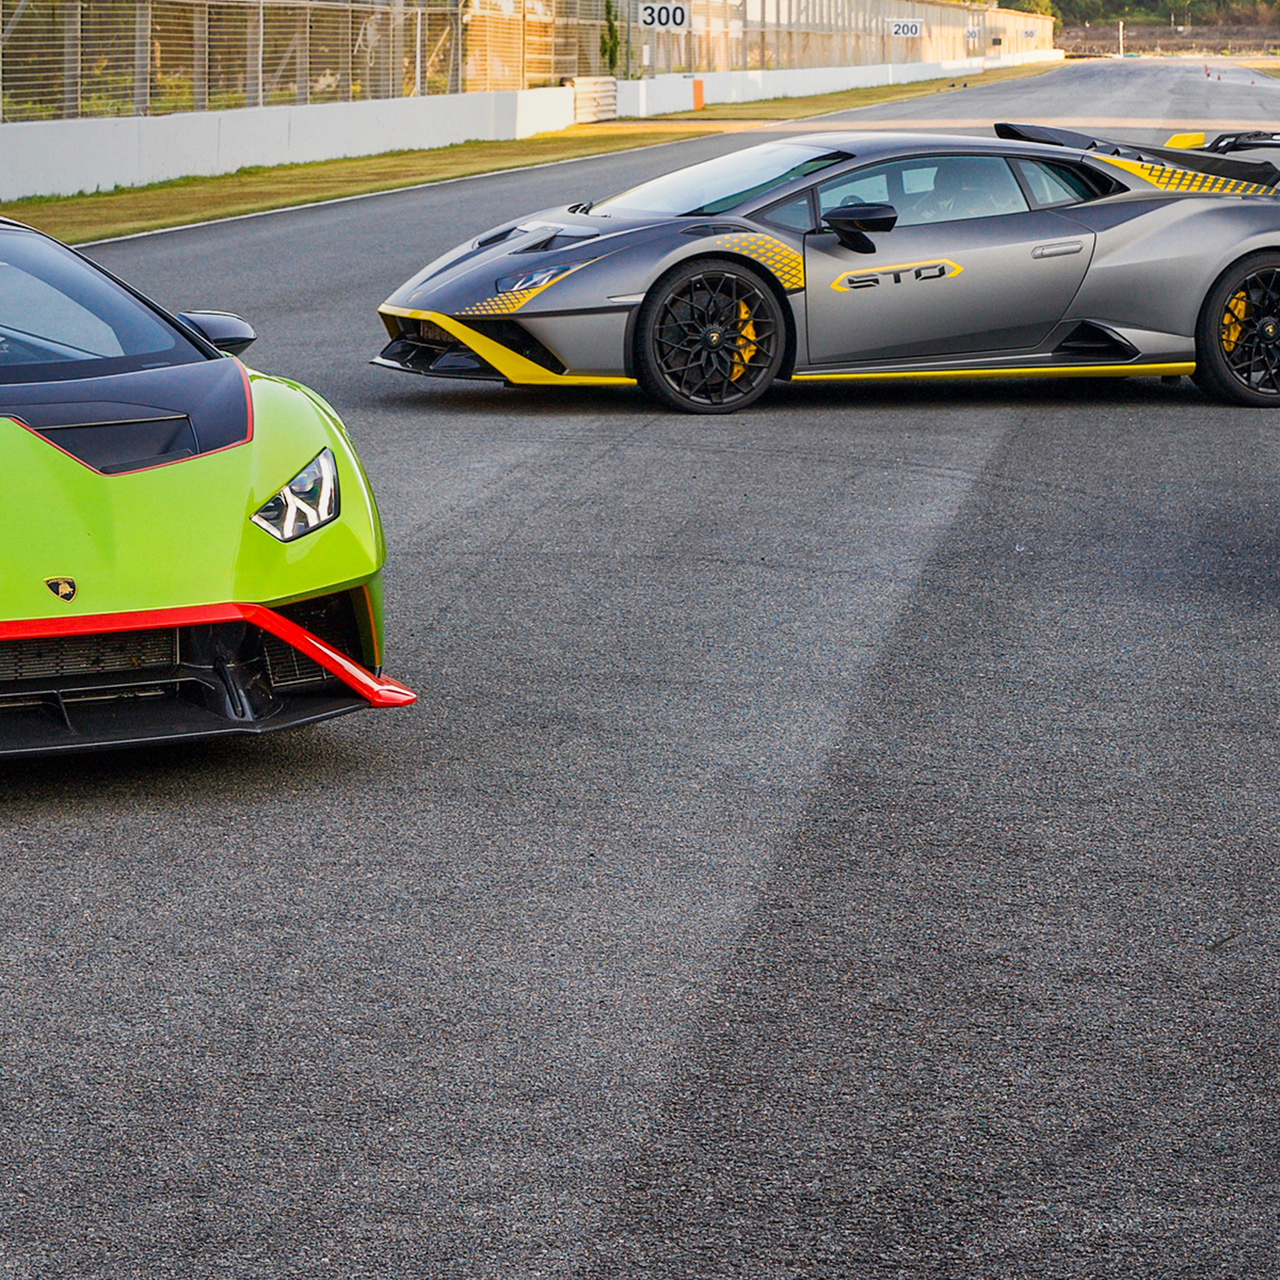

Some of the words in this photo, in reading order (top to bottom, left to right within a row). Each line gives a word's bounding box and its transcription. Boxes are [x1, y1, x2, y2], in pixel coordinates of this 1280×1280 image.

[642, 6, 685, 26] 300
[894, 24, 918, 35] 200
[847, 264, 946, 290] STO
